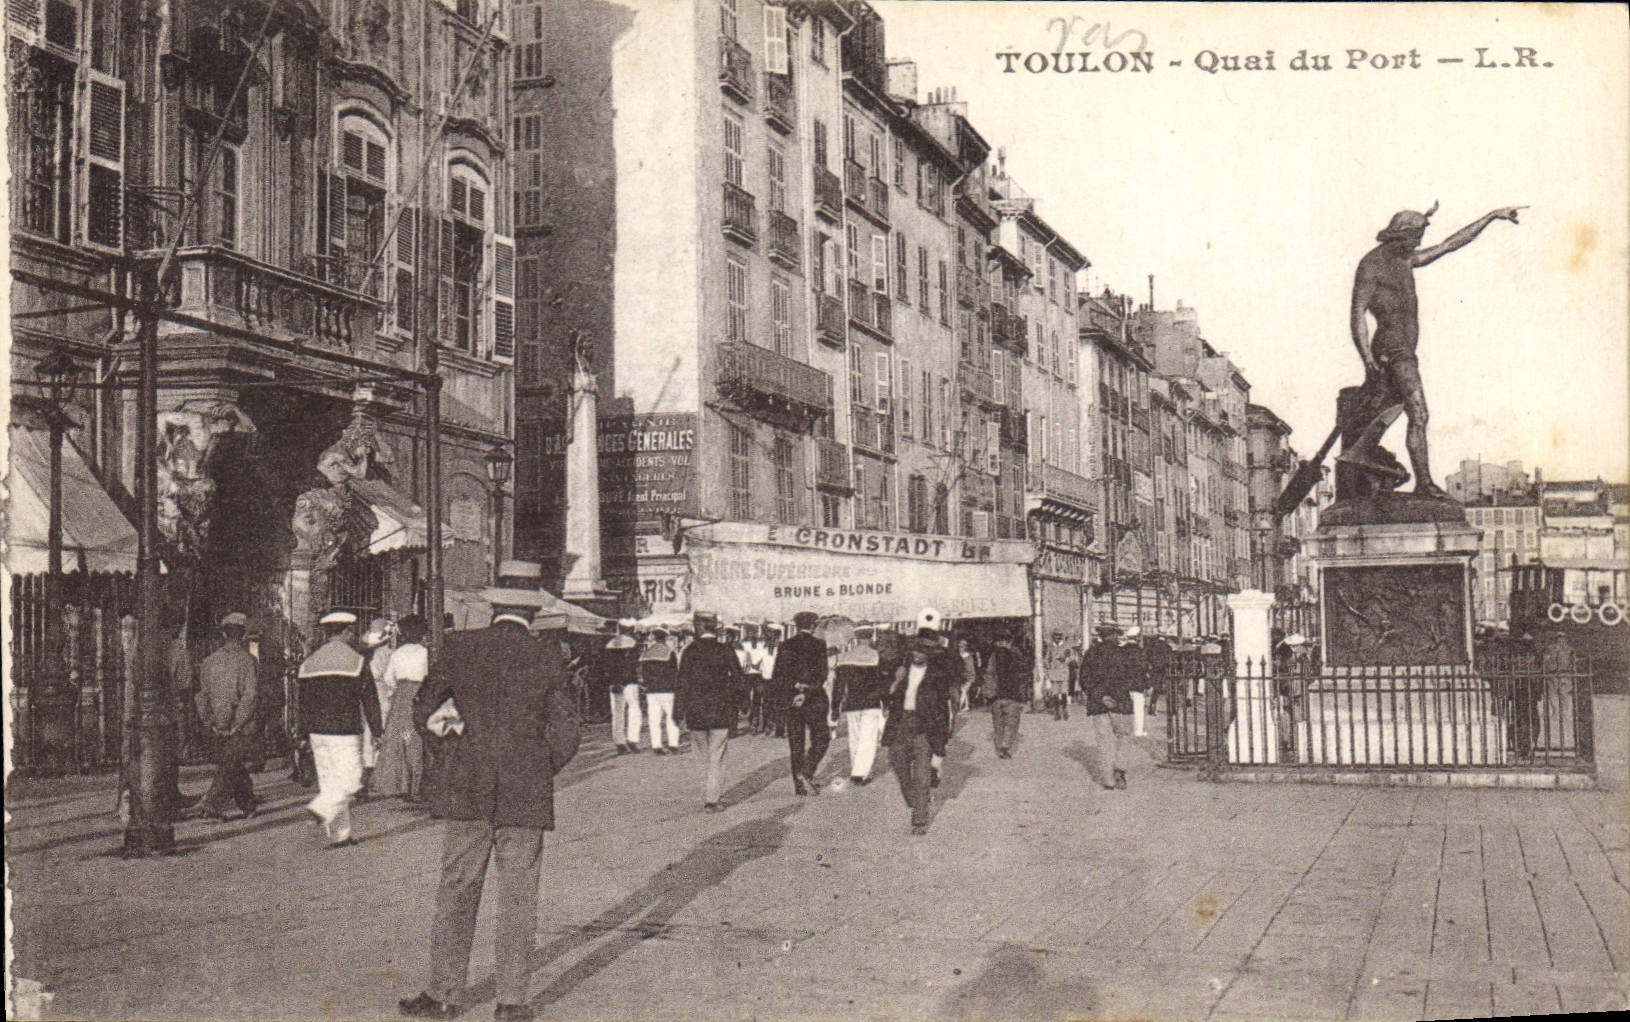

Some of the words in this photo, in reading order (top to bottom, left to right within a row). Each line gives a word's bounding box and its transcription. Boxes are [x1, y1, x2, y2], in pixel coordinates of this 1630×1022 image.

[795, 527, 944, 557] CRONSTADT
[774, 585, 822, 599] BRUNE
[839, 582, 893, 597] BLONDE
